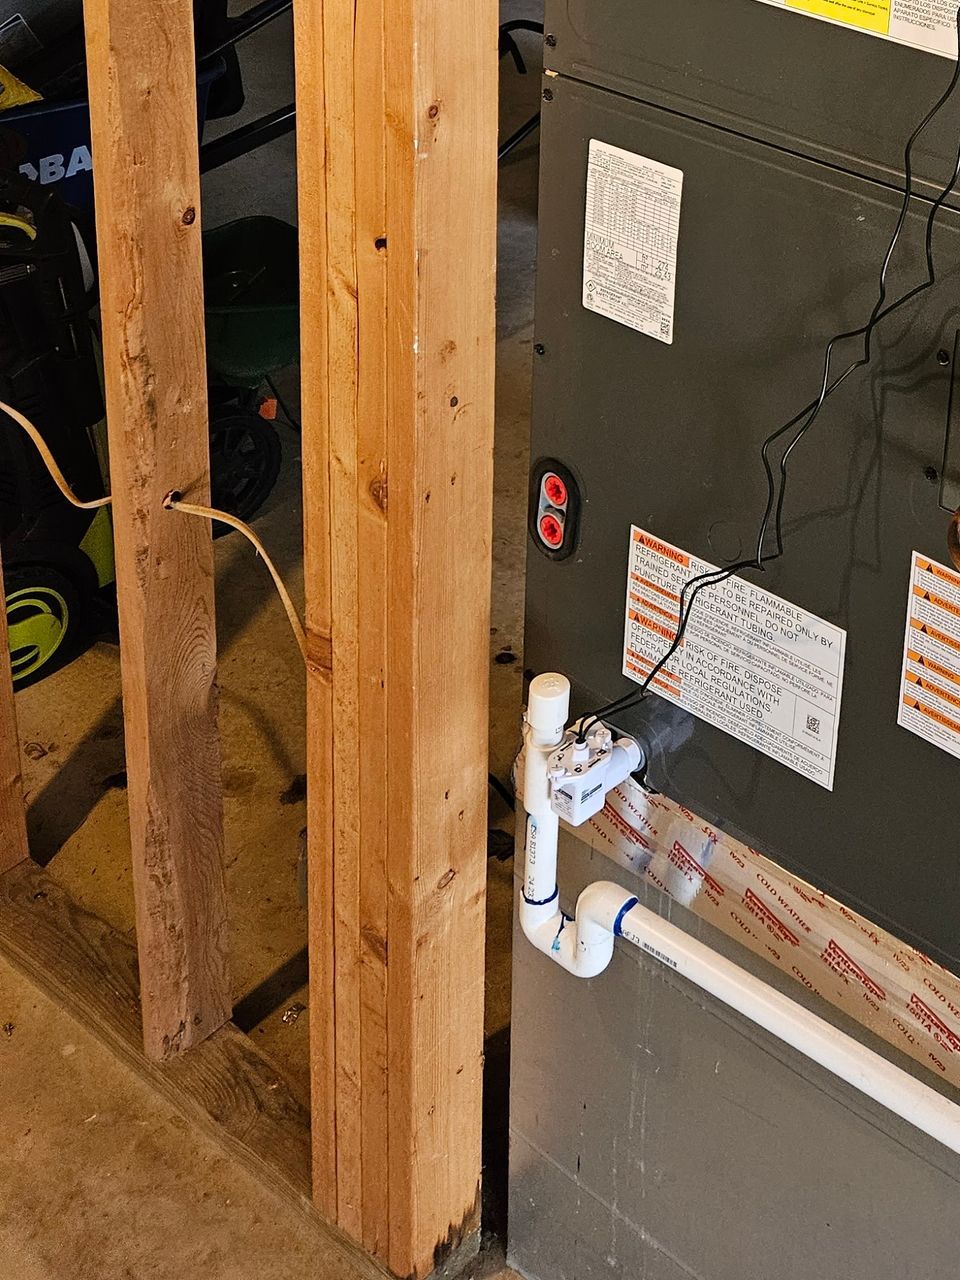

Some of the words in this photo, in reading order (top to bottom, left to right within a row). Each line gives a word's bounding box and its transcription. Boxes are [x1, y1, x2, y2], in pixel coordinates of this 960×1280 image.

[634, 553, 668, 578] TRAINED
[708, 589, 762, 626] PERSONNEL.
[765, 618, 778, 633] DO
[780, 626, 798, 643] NOT
[634, 564, 676, 593] PUNCTURE
[679, 586, 737, 624] RERIGERANT
[740, 617, 775, 642] TUBING.
[635, 543, 692, 579] REFRIGERANT
[721, 586, 733, 599] TO
[735, 593, 746, 606] BE
[749, 599, 792, 629] REPAIRED
[794, 622, 817, 642] ONLY
[820, 636, 832, 649] BY
[645, 537, 683, 563] WARNING
[726, 577, 747, 595] FIRE.
[750, 588, 802, 622] FLAMMABLE
[630, 631, 665, 657] FEDERAL
[681, 658, 708, 680] LOCAL
[710, 673, 772, 715] REGULATIONS.
[678, 667, 736, 706] REFRIGERANT
[739, 699, 765, 721] USED.
[685, 639, 704, 657] RISK
[706, 650, 718, 664] OF
[720, 657, 742, 676] FIRE.
[744, 669, 782, 697] DISPOSE
[685, 651, 694, 662] IN
[695, 654, 754, 694] ACCORDANCE
[756, 687, 779, 706] WITH
[927, 661, 954, 680] WARNING
[628, 802, 659, 836] WEATHER
[745, 887, 800, 948] VentureTape
[757, 873, 777, 896] COLD
[777, 895, 813, 934] WEATHER
[828, 939, 887, 1001] VentureTape
[923, 977, 946, 1003] COLD
